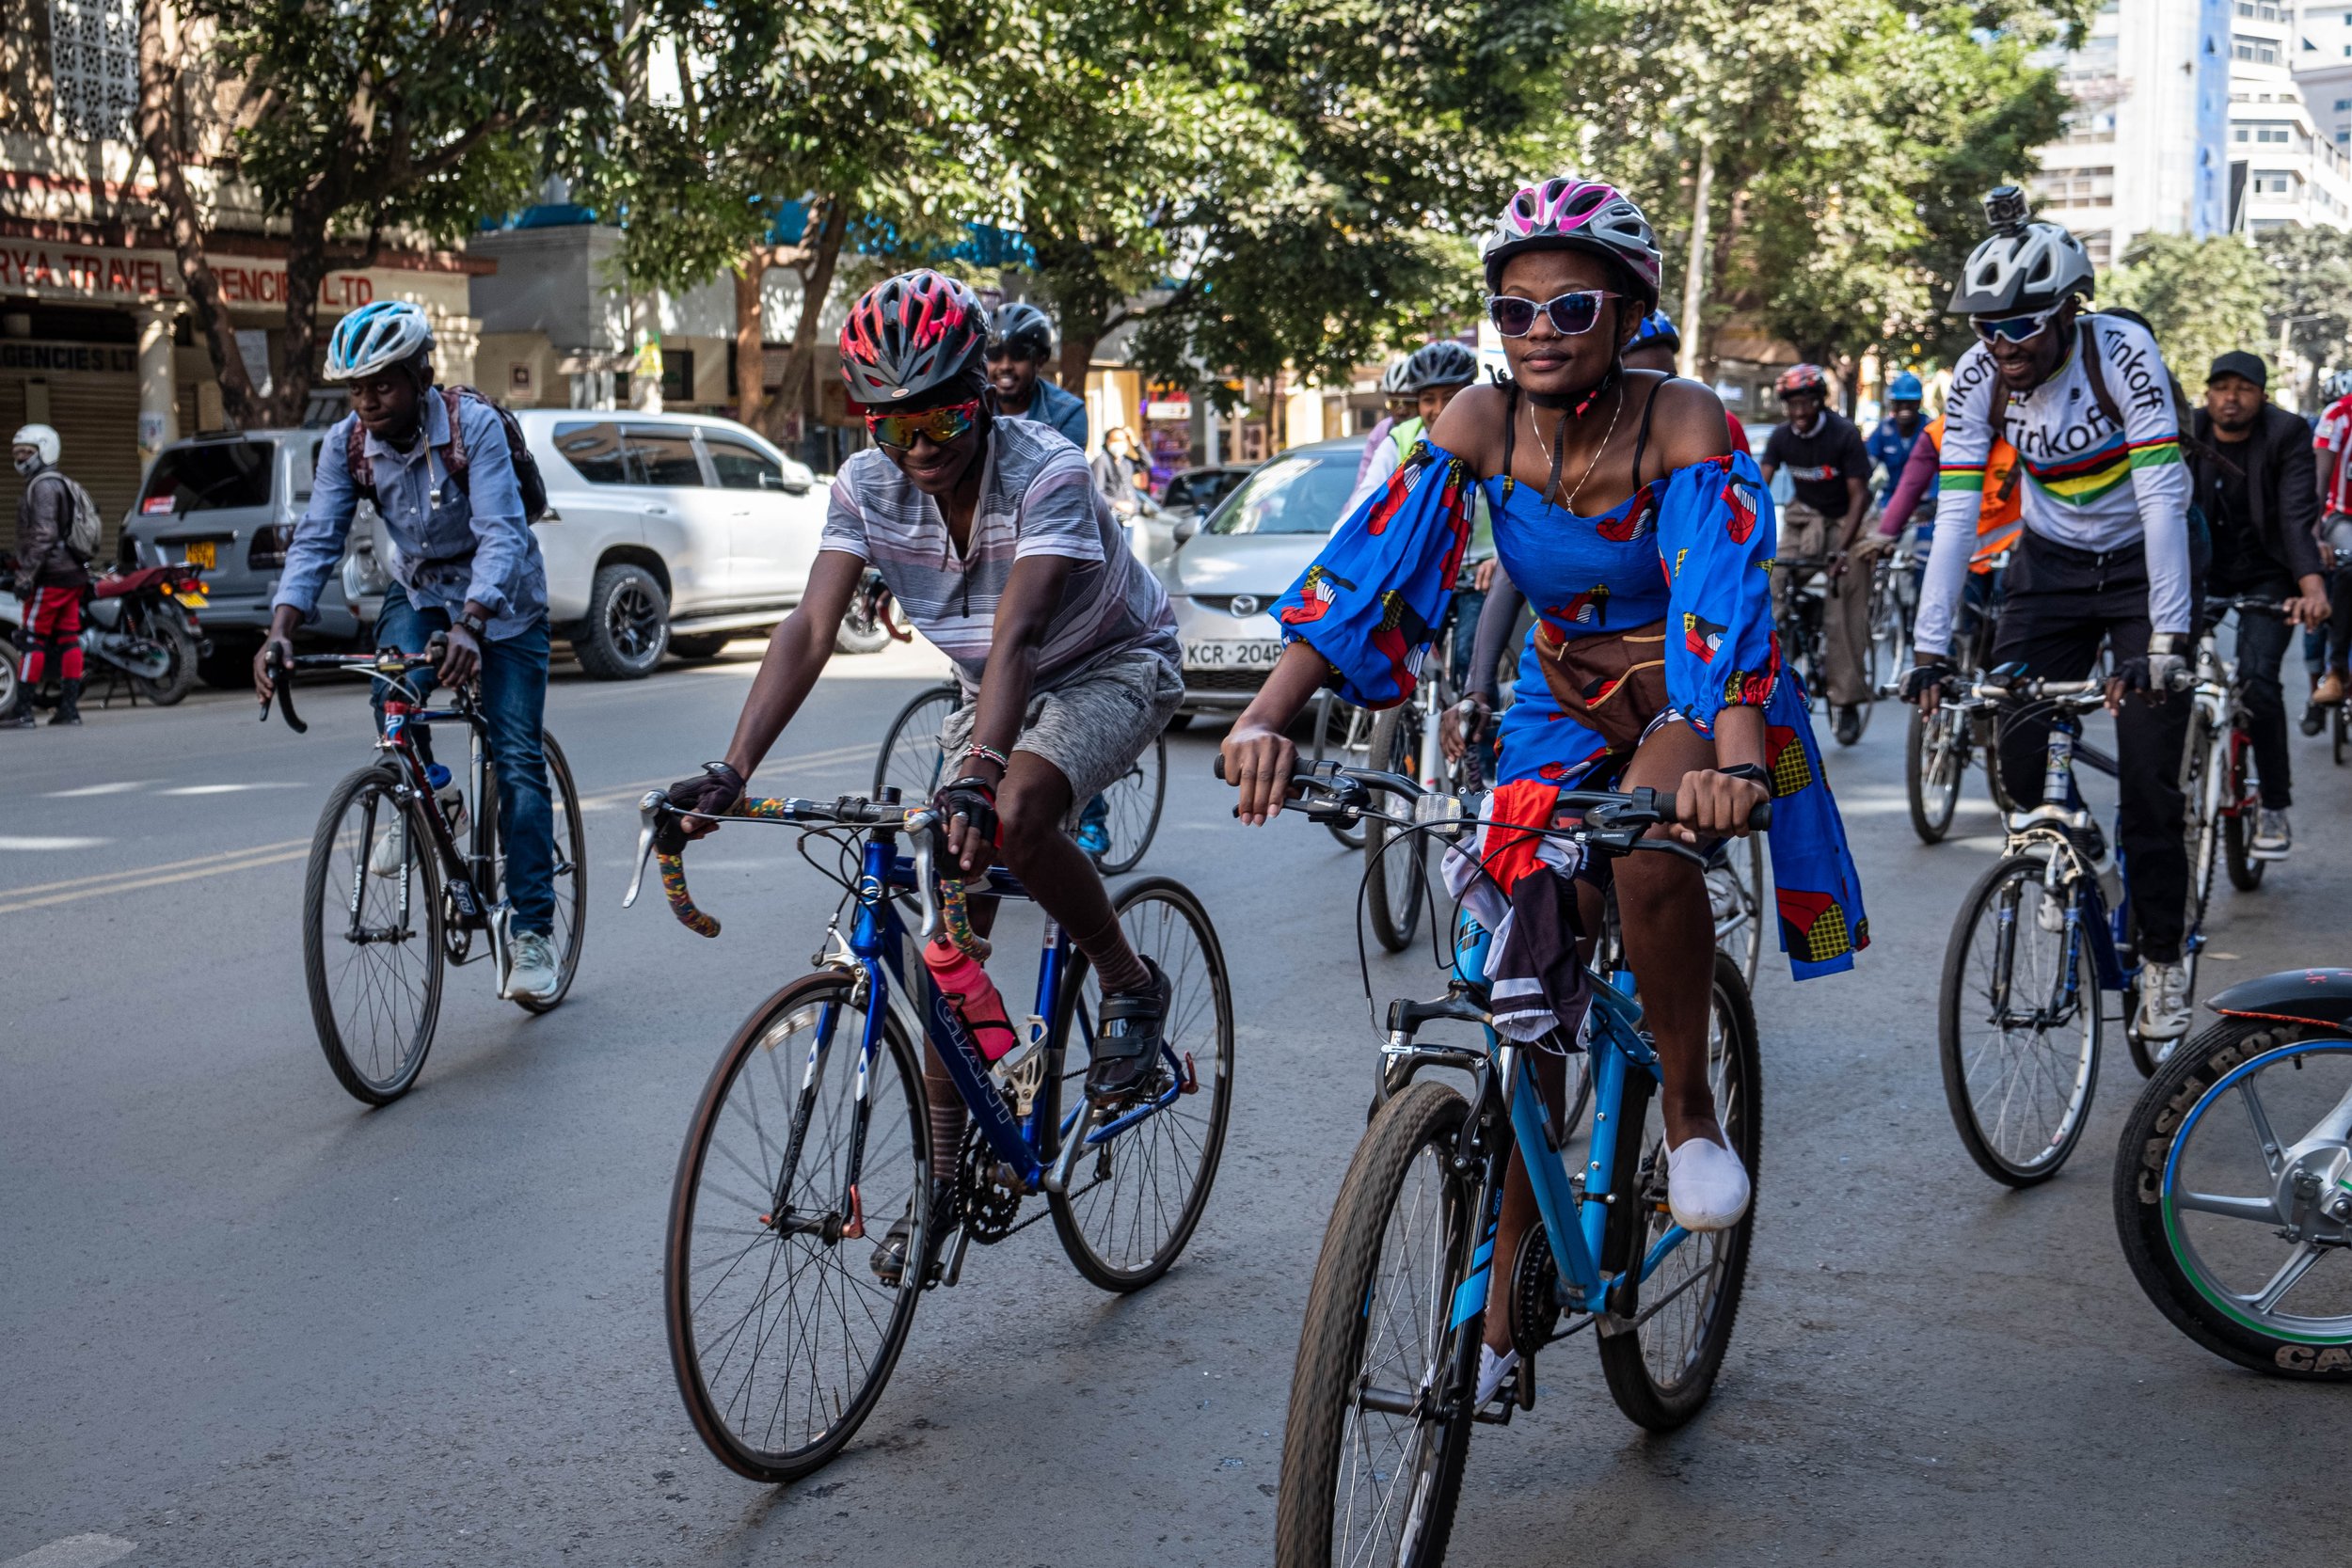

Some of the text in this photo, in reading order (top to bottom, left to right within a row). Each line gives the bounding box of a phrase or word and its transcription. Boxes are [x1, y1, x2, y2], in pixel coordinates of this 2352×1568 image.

[63, 254, 176, 295] TRAVEL
[210, 267, 288, 302] ENCI
[322, 275, 373, 307] LTD
[2, 344, 138, 372] GENCIES LT
[2104, 328, 2165, 411] Tinkoff
[1187, 643, 1282, 664] KCR 204P
[936, 996, 1013, 1125] GIANT
[2137, 1075, 2210, 1205] CASH
[2275, 1345, 2352, 1372] CA
